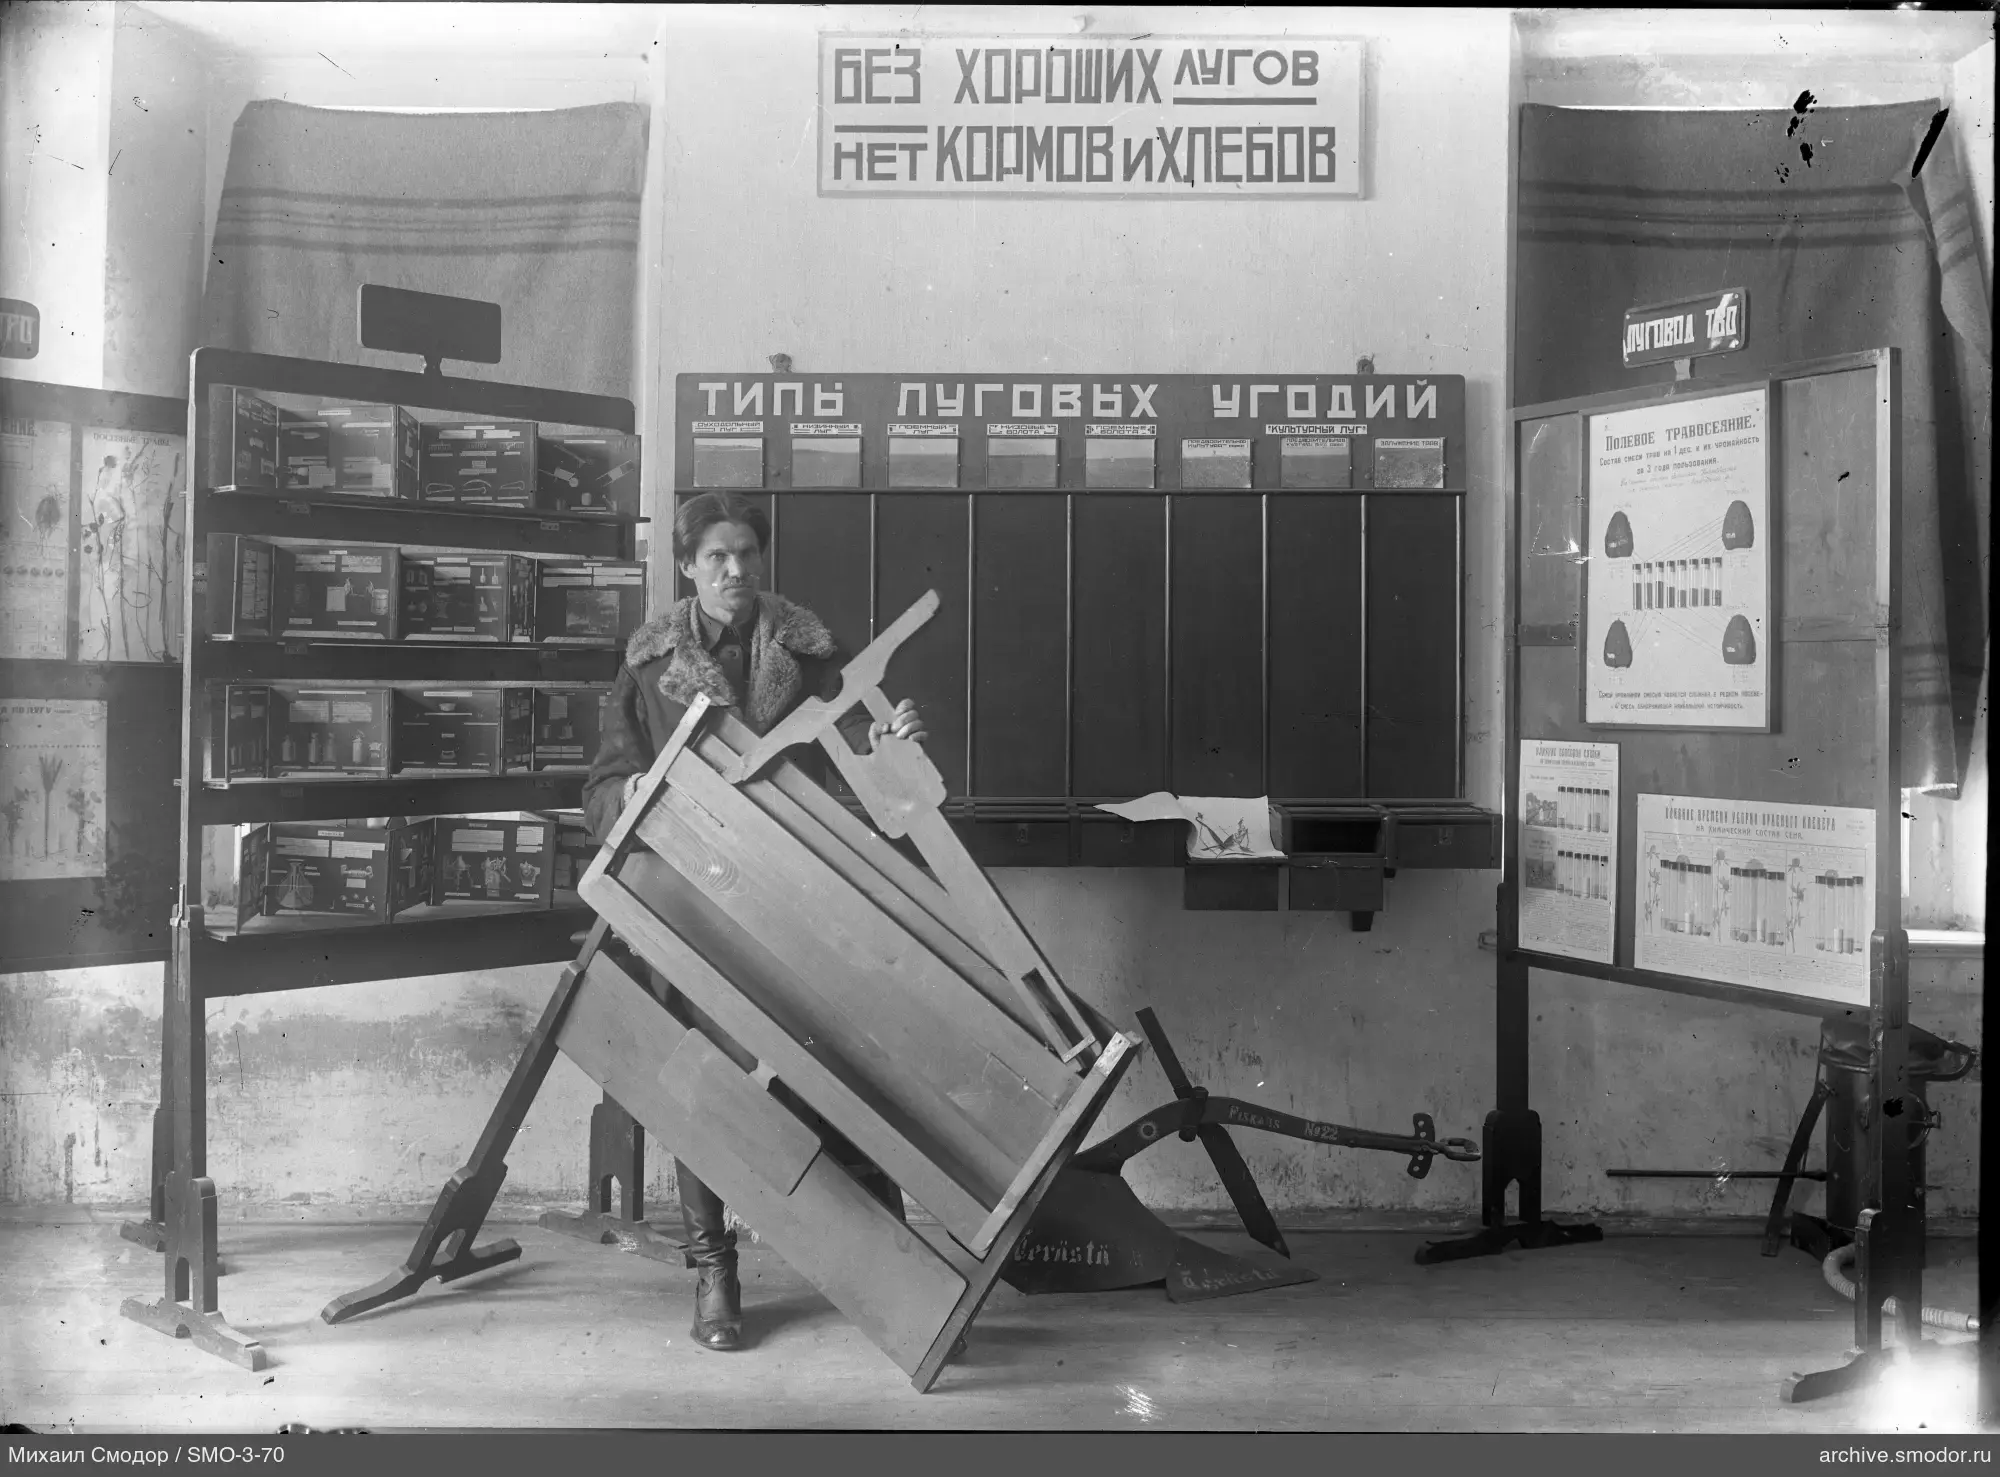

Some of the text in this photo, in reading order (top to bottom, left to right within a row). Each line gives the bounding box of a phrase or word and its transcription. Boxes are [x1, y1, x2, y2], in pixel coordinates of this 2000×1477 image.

[834, 48, 1319, 104] БЕЗ ХОРОШИХ ЛУГОВ
[834, 141, 928, 181] НЕТ
[936, 125, 1114, 182] КОРМОВ
[1156, 126, 1336, 183] ХЛЕБОВ
[1626, 313, 1695, 354] ЛУГОВОД
[698, 379, 1437, 419] ТИПЫ ЛУГОВЫХ УГОДИЙ
[1605, 415, 1756, 451] ПОЛЕВОЕ ТРАВОСЕЯНИЕ.
